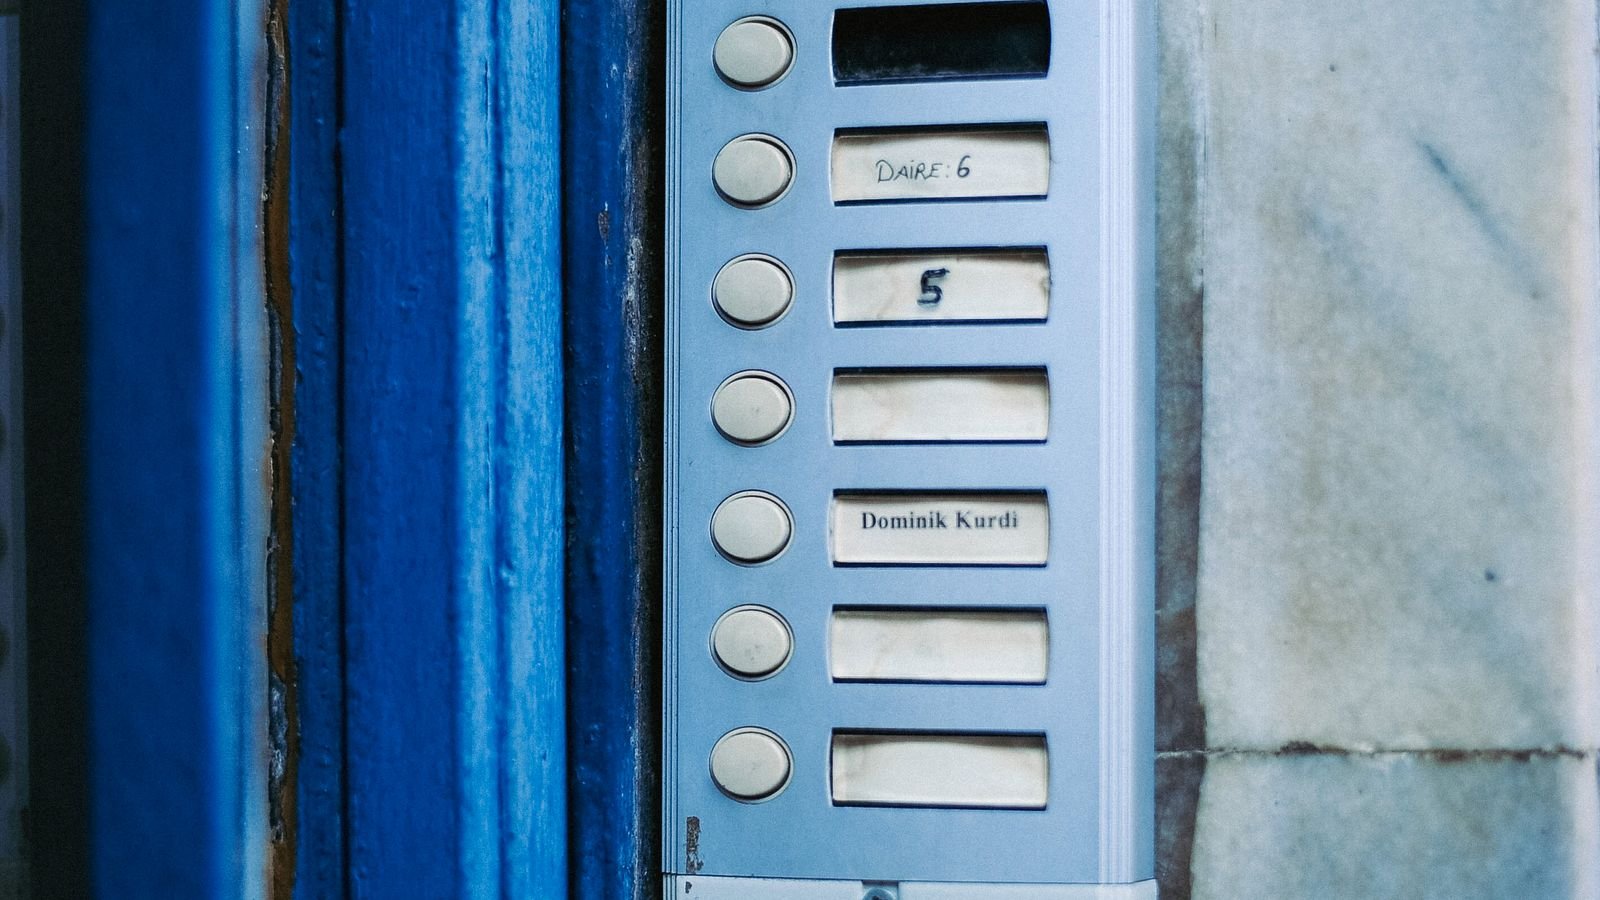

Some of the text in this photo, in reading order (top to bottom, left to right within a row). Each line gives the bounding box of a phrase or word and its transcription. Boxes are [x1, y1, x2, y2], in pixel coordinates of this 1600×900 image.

[916, 267, 951, 307] 5
[861, 509, 1020, 530] Dominik Kurdi
